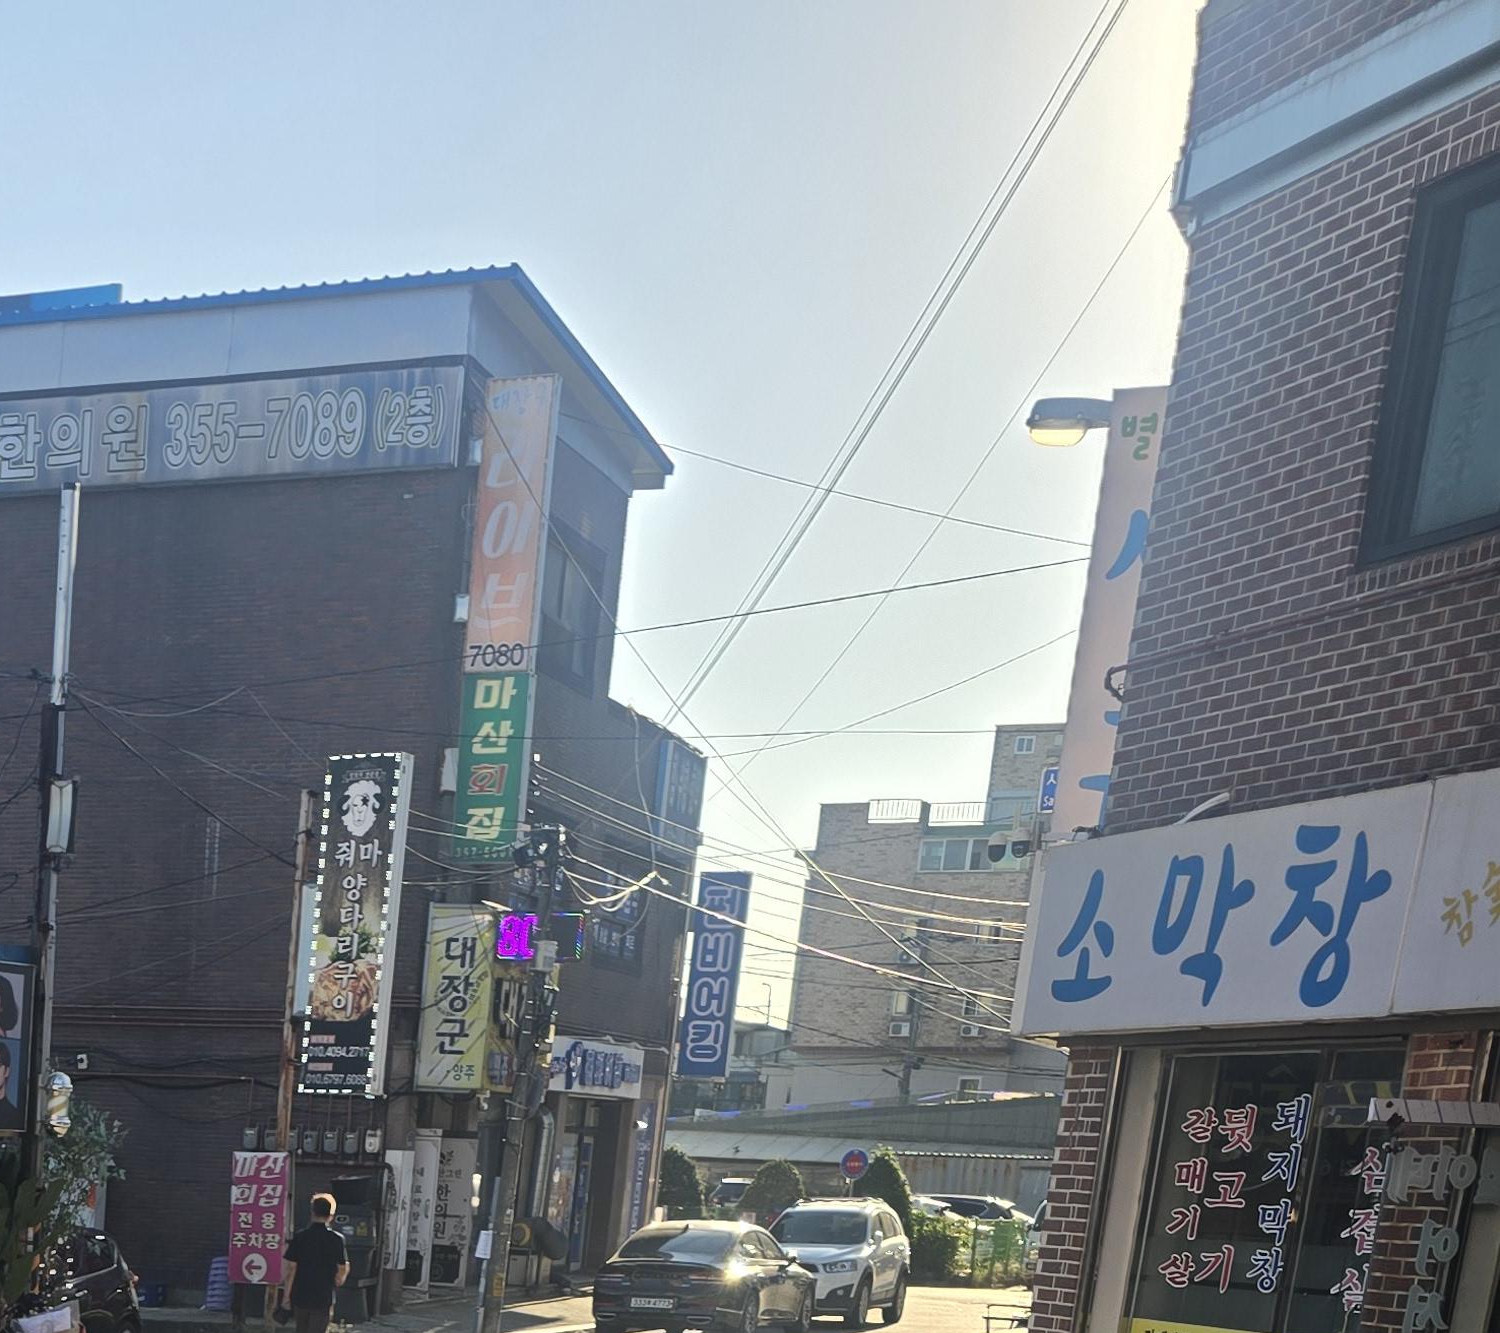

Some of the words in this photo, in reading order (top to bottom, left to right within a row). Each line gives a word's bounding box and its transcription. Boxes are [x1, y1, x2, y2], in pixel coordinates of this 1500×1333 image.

[163, 389, 366, 469] 355-7089
[374, 384, 446, 454] (2층)
[469, 643, 524, 667] 7080
[466, 677, 518, 840] 마산회집
[435, 936, 477, 1056] 대장군
[233, 1232, 280, 1249] 주차장
[1246, 1093, 1312, 1294] 돼지막창
